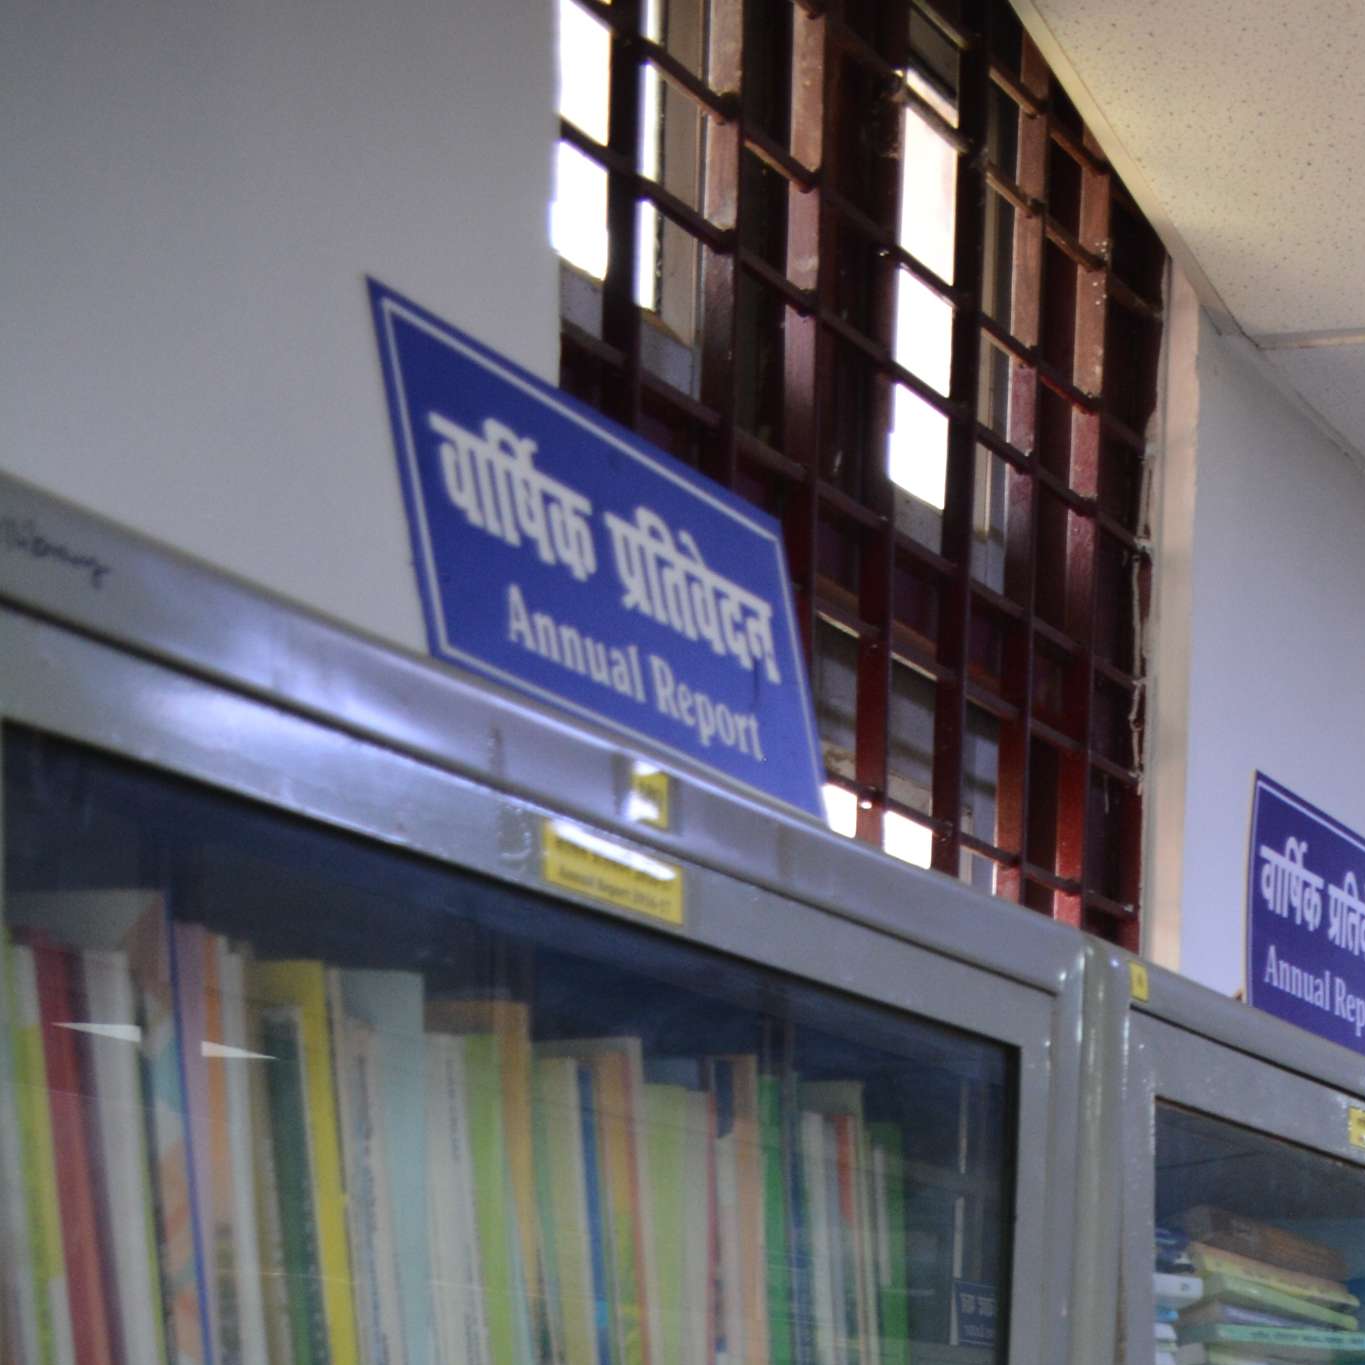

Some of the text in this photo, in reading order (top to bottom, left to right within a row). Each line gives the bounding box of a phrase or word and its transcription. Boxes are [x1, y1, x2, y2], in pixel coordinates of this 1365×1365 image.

[430, 411, 776, 685] वार्षिक प्रतिवेदन
[508, 584, 764, 763] Annual Report
[1260, 836, 1325, 932] वार्षिक
[1264, 945, 1330, 1012] Annual
